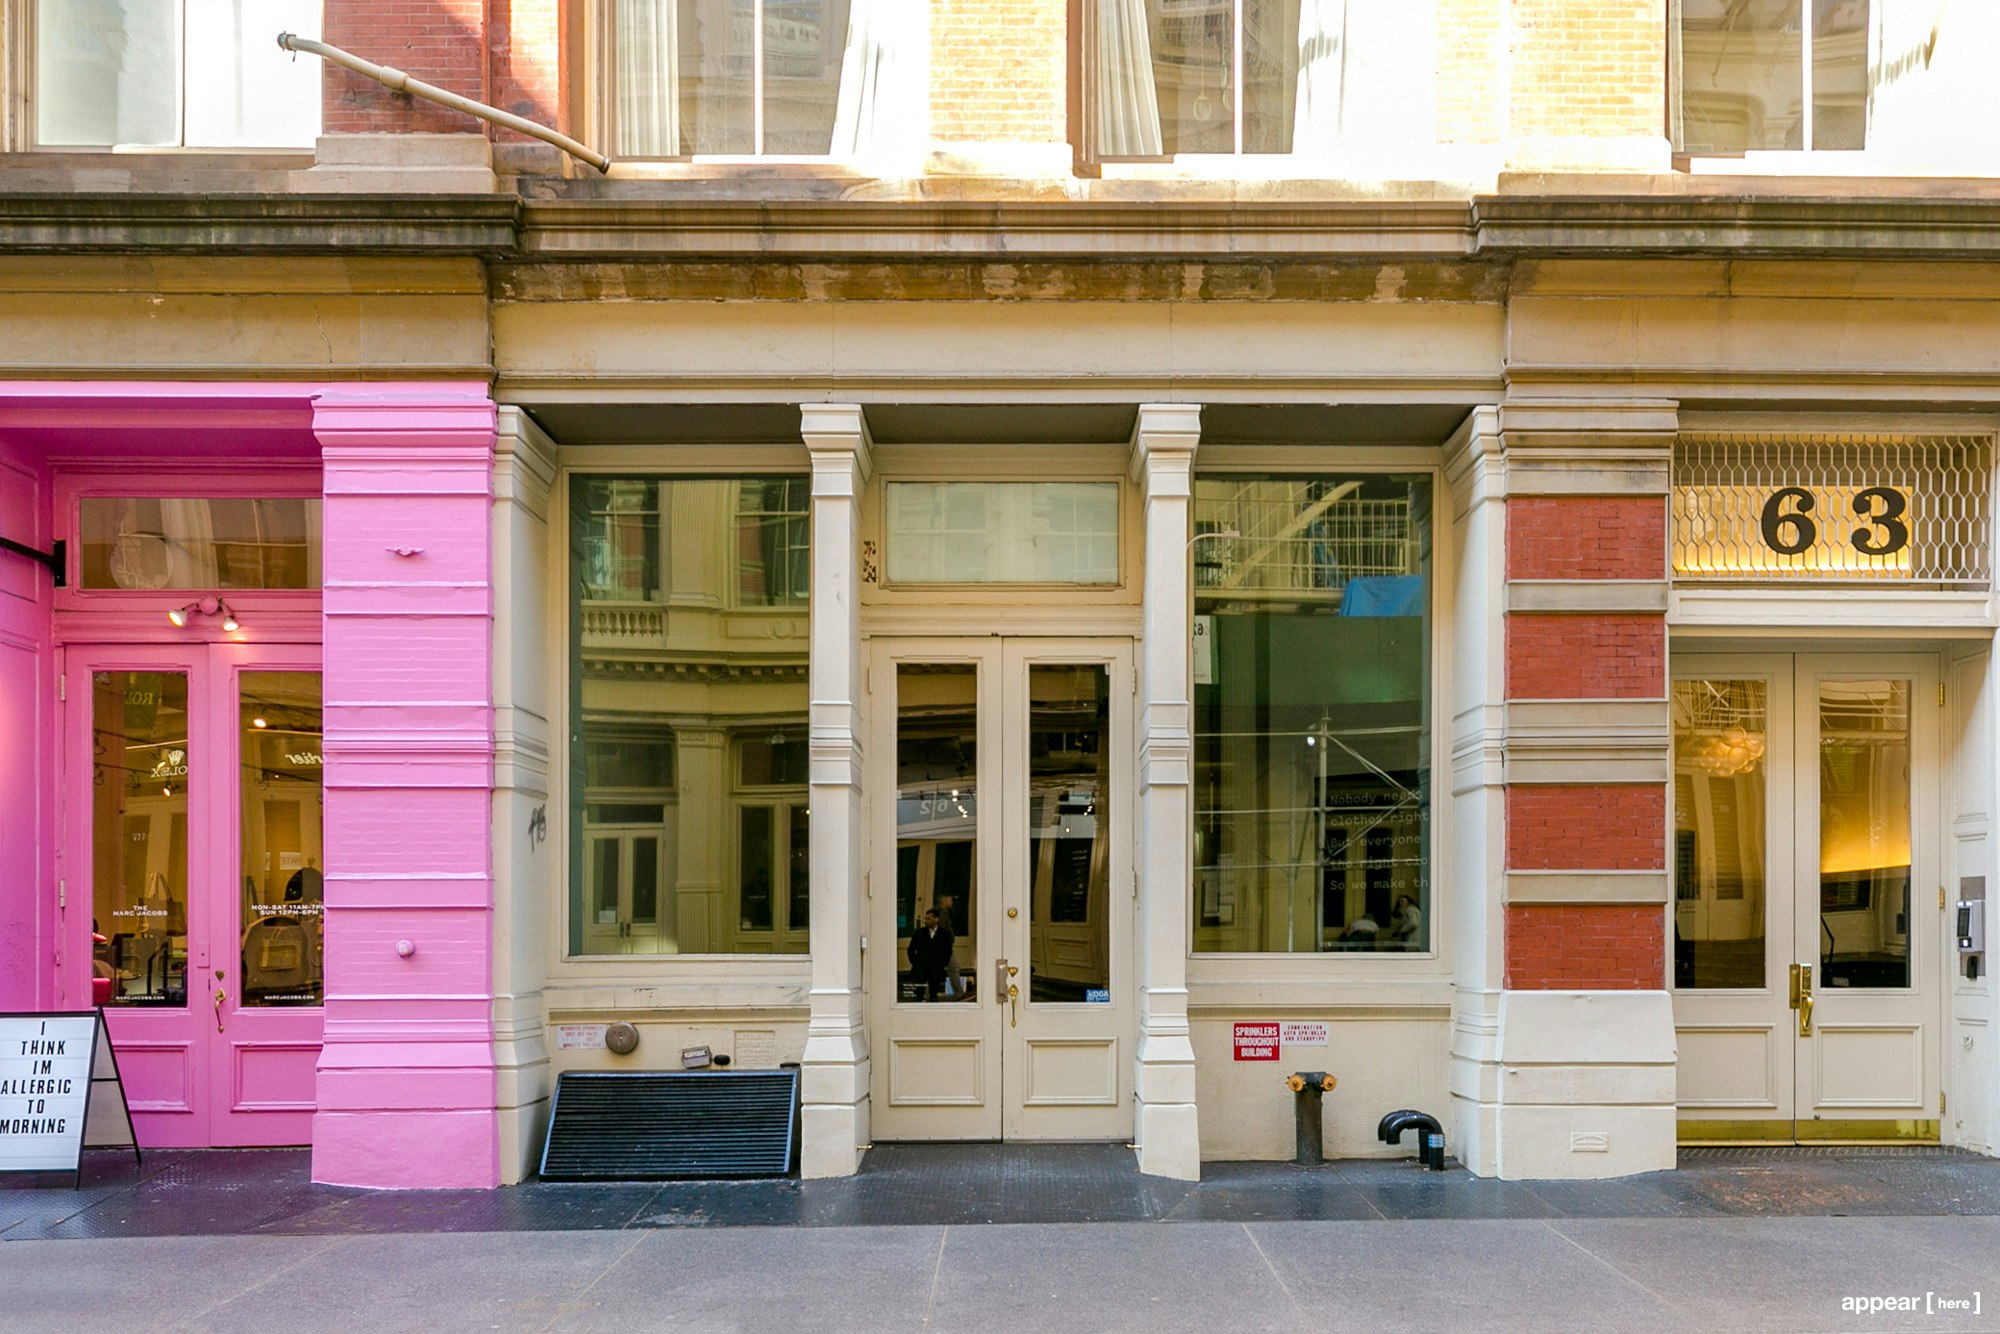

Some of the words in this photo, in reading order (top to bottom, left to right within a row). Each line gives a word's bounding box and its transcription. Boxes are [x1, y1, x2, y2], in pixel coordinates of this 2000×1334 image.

[1329, 793, 1377, 805] Nobody
[1390, 811, 1429, 825] right
[1359, 835, 1421, 848] everyone
[1405, 855, 1428, 866] clo
[1330, 880, 1345, 890] So
[1351, 881, 1367, 890] we
[1373, 878, 1406, 889] make
[1413, 877, 1429, 888] th
[41, 1021, 46, 1036] I
[1235, 1027, 1277, 1036] SPRINKLERS
[21, 1040, 66, 1056] THINK
[1234, 1037, 1279, 1047] THROUGHOUT
[1241, 1047, 1272, 1057] BUILDING
[32, 1060, 52, 1075] IM
[1, 1079, 72, 1095] ALLERGIC
[27, 1099, 45, 1114] TO
[0, 1119, 66, 1134] MORNING
